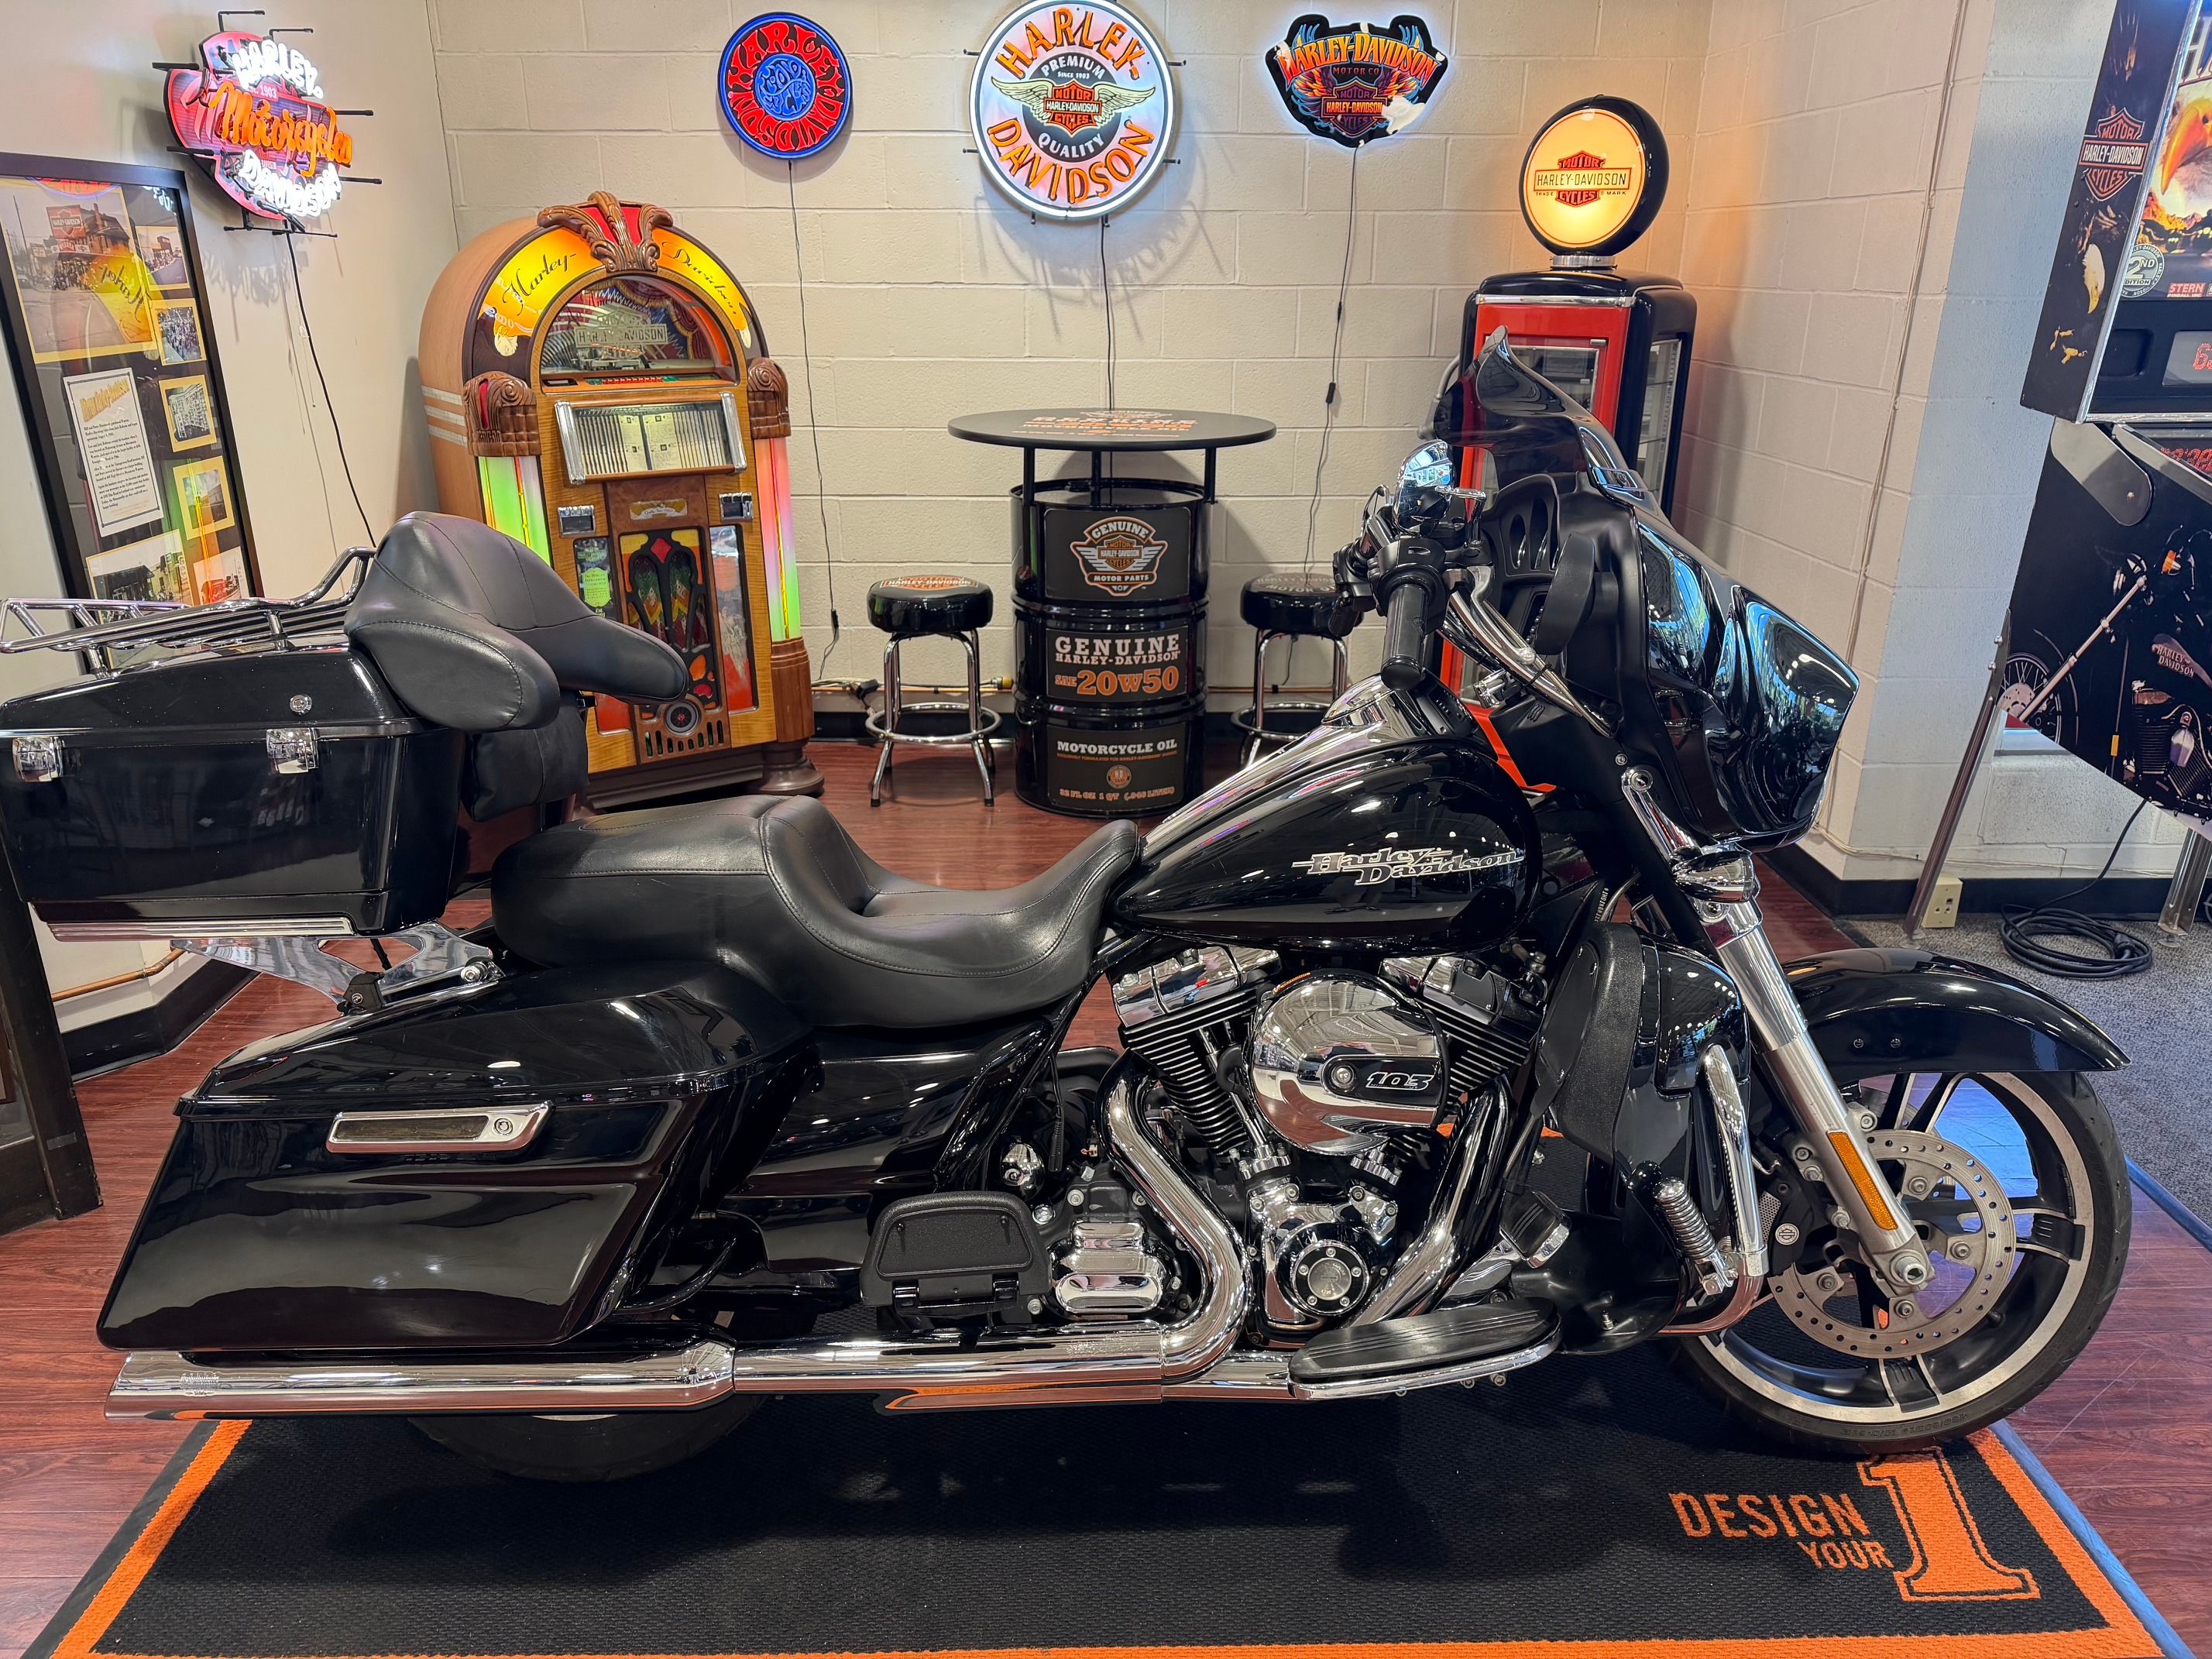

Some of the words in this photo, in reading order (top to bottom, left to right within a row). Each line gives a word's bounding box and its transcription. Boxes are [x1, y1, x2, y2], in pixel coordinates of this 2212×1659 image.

[996, 8, 1146, 80] HARLEY-
[1278, 33, 1441, 85] HARLEY-DAVIDSON
[1041, 56, 1105, 80] PREMIUM
[1333, 67, 1365, 75] MOTOR
[259, 81, 277, 99] 1903
[1055, 85, 1091, 101] MOTOR
[1341, 90, 1369, 99] MOTOR
[1046, 101, 1099, 114] HARLEY-DAVIDSON
[1326, 101, 1382, 115] HARLEY-DAVIDSON
[1054, 113, 1090, 126] CYCLES
[1338, 116, 1369, 130] CYCLES
[2101, 118, 2135, 139] MOTOR
[1038, 132, 1105, 158] QUALITY
[988, 118, 1156, 204] DAVIDSON
[1562, 154, 1599, 169] MOTOR
[2082, 144, 2145, 166] HARLEY-DAVIDSON
[1537, 173, 1626, 187] HARLEY-DAVIDSON
[2091, 168, 2124, 193] CYCLES
[1558, 190, 1595, 205] CYCLES
[503, 253, 576, 316] Harley-
[2169, 283, 2204, 293] STERN
[1091, 521, 1149, 539] GENUINE
[1101, 549, 1139, 558] HARLEY-DAVIDSON
[1109, 558, 1131, 568] CYCLES
[1055, 634, 1180, 656] GENUINE
[2155, 644, 2186, 661] HARLEY
[1056, 651, 1180, 665] HARLEY-DAVIDSON
[2158, 655, 2195, 678] DAVIDSON
[1055, 675, 1077, 687] SAE
[1057, 740, 1153, 755] MOTORCYCLE
[1156, 739, 1177, 751] OIL
[1070, 790, 1082, 799] FL
[1106, 793, 1119, 802] QT
[1354, 852, 1524, 885] Davidson
[1365, 1071, 1434, 1091] 103
[1668, 1492, 1870, 1537] DESIGN
[1857, 1448, 2042, 1602] 1
[1798, 1541, 1894, 1569] YOUR
